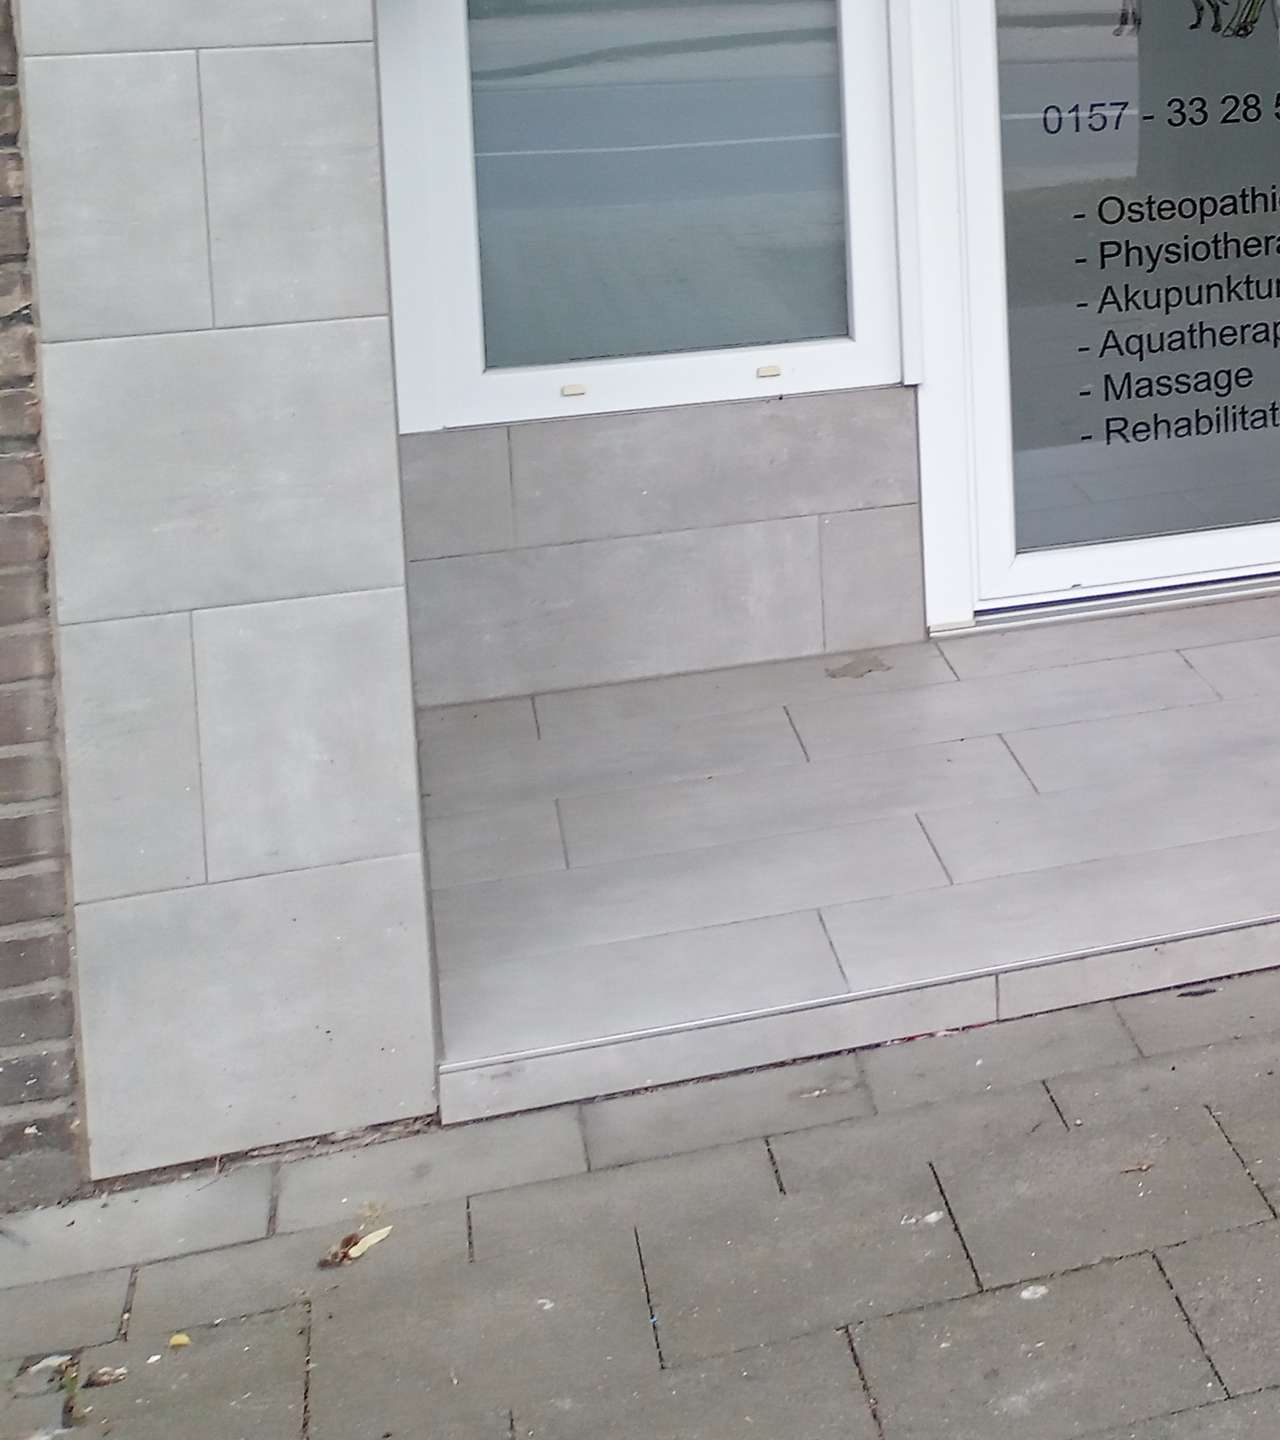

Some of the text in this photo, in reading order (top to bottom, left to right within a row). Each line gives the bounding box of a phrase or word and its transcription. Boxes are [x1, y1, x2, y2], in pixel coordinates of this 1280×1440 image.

[1043, 101, 1129, 135] 0157
[1167, 97, 1207, 127] 33
[1220, 94, 1261, 125] 28
[1104, 366, 1253, 401] Massage
